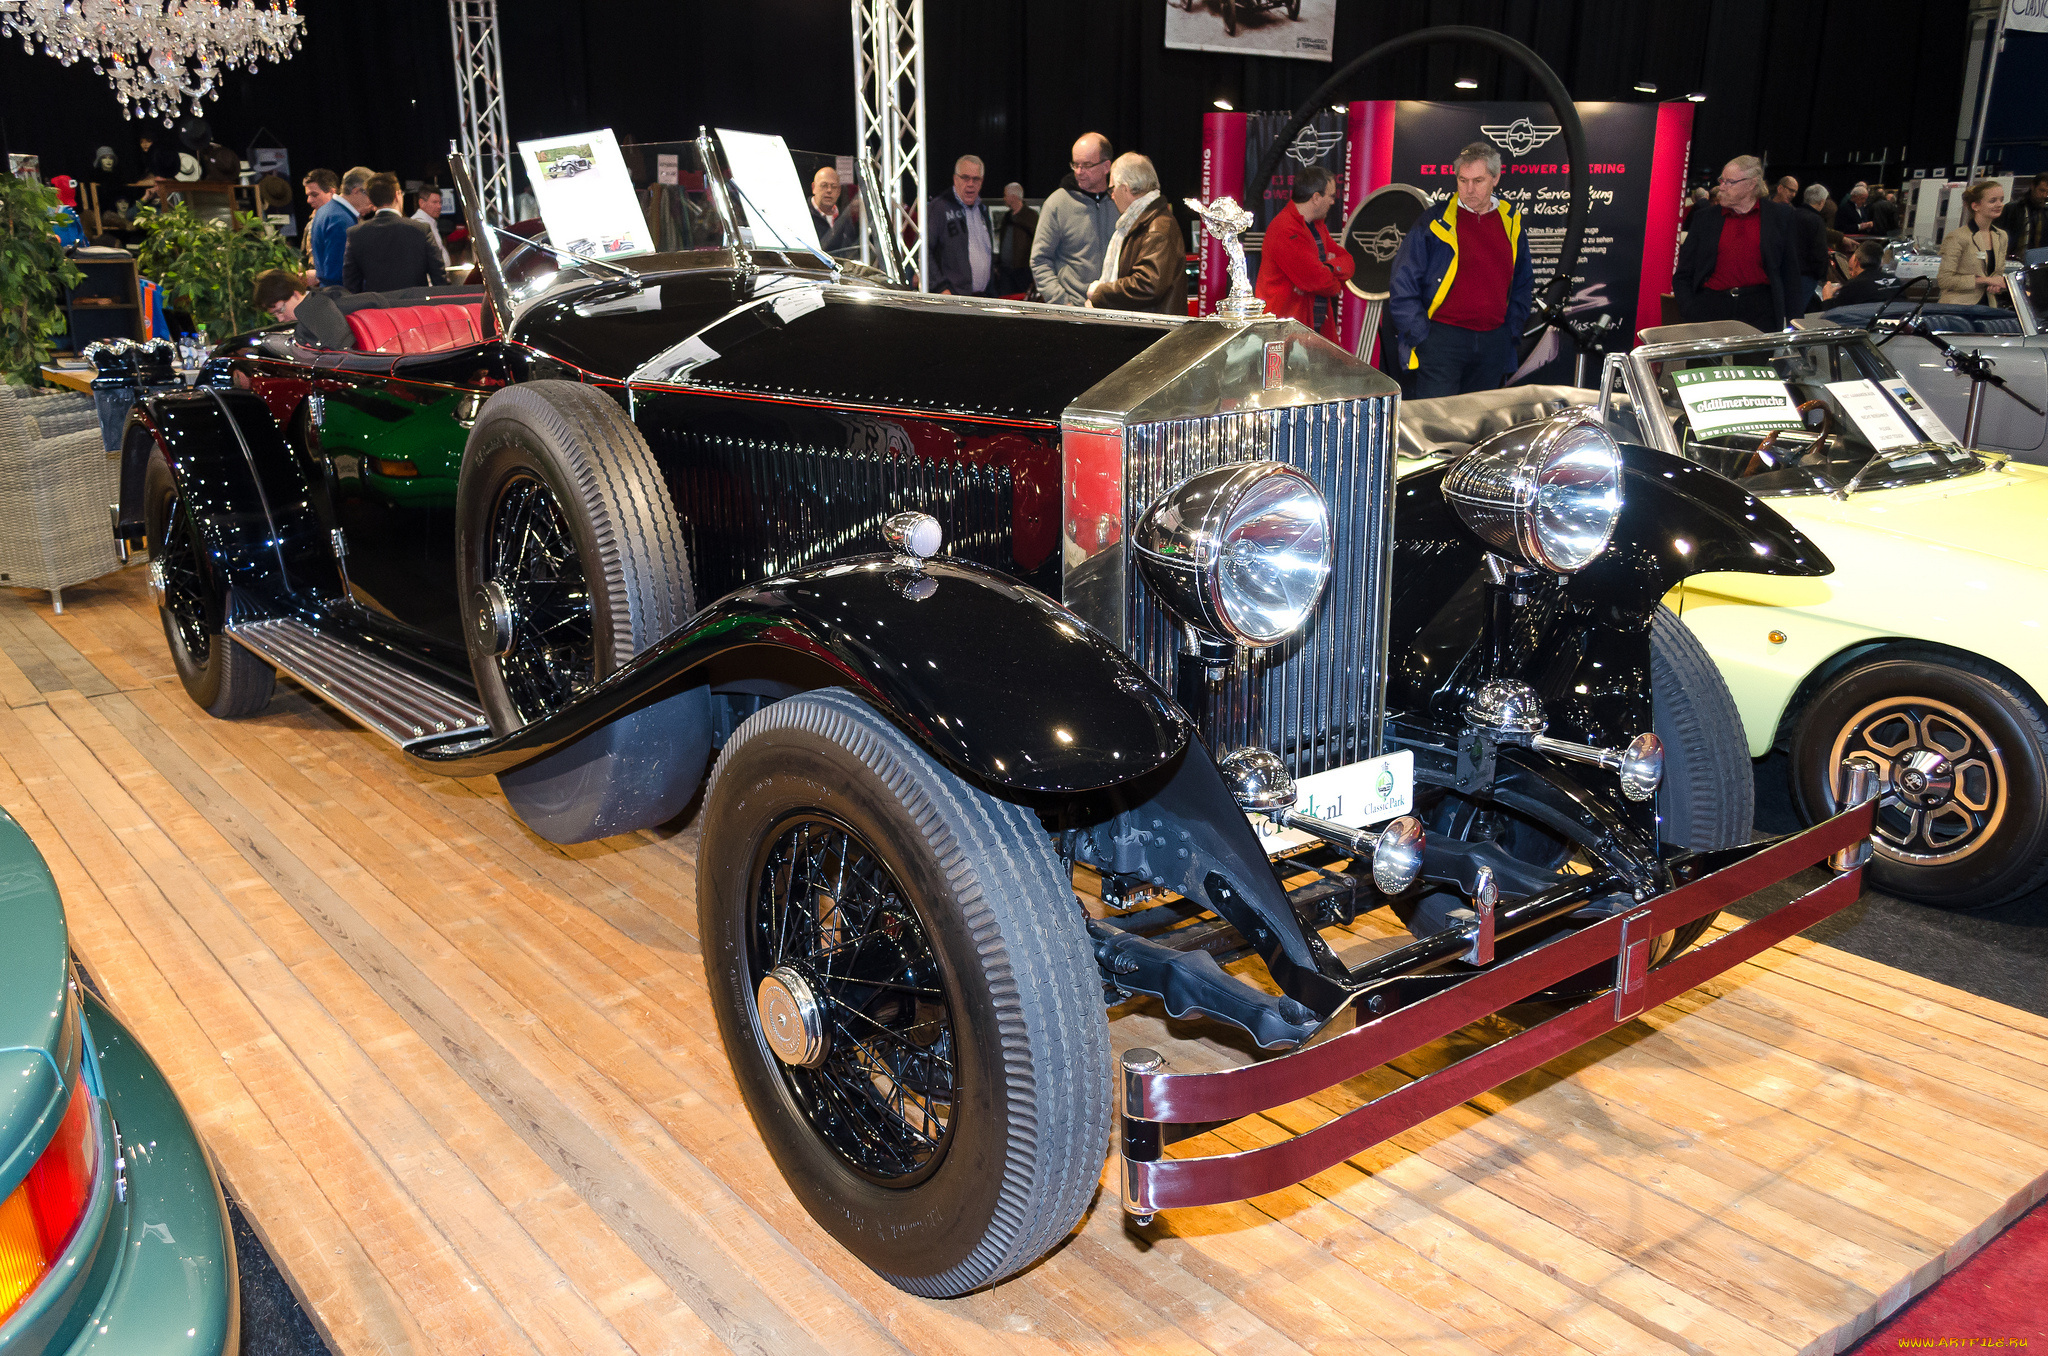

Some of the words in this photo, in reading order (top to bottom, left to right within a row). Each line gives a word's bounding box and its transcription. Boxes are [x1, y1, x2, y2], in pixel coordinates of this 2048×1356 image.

[1202, 148, 1212, 205] EERING
[1342, 141, 1352, 223] STEERING
[1421, 164, 1436, 175] EZ
[1511, 164, 1558, 175] POWER
[1561, 164, 1625, 174] SERING
[1200, 229, 1209, 279] POWER
[1677, 372, 1705, 384] WIJ
[1713, 369, 1746, 380] ZIJN
[1752, 370, 1776, 379] LID
[1697, 395, 1786, 413] oldtimerbranche
